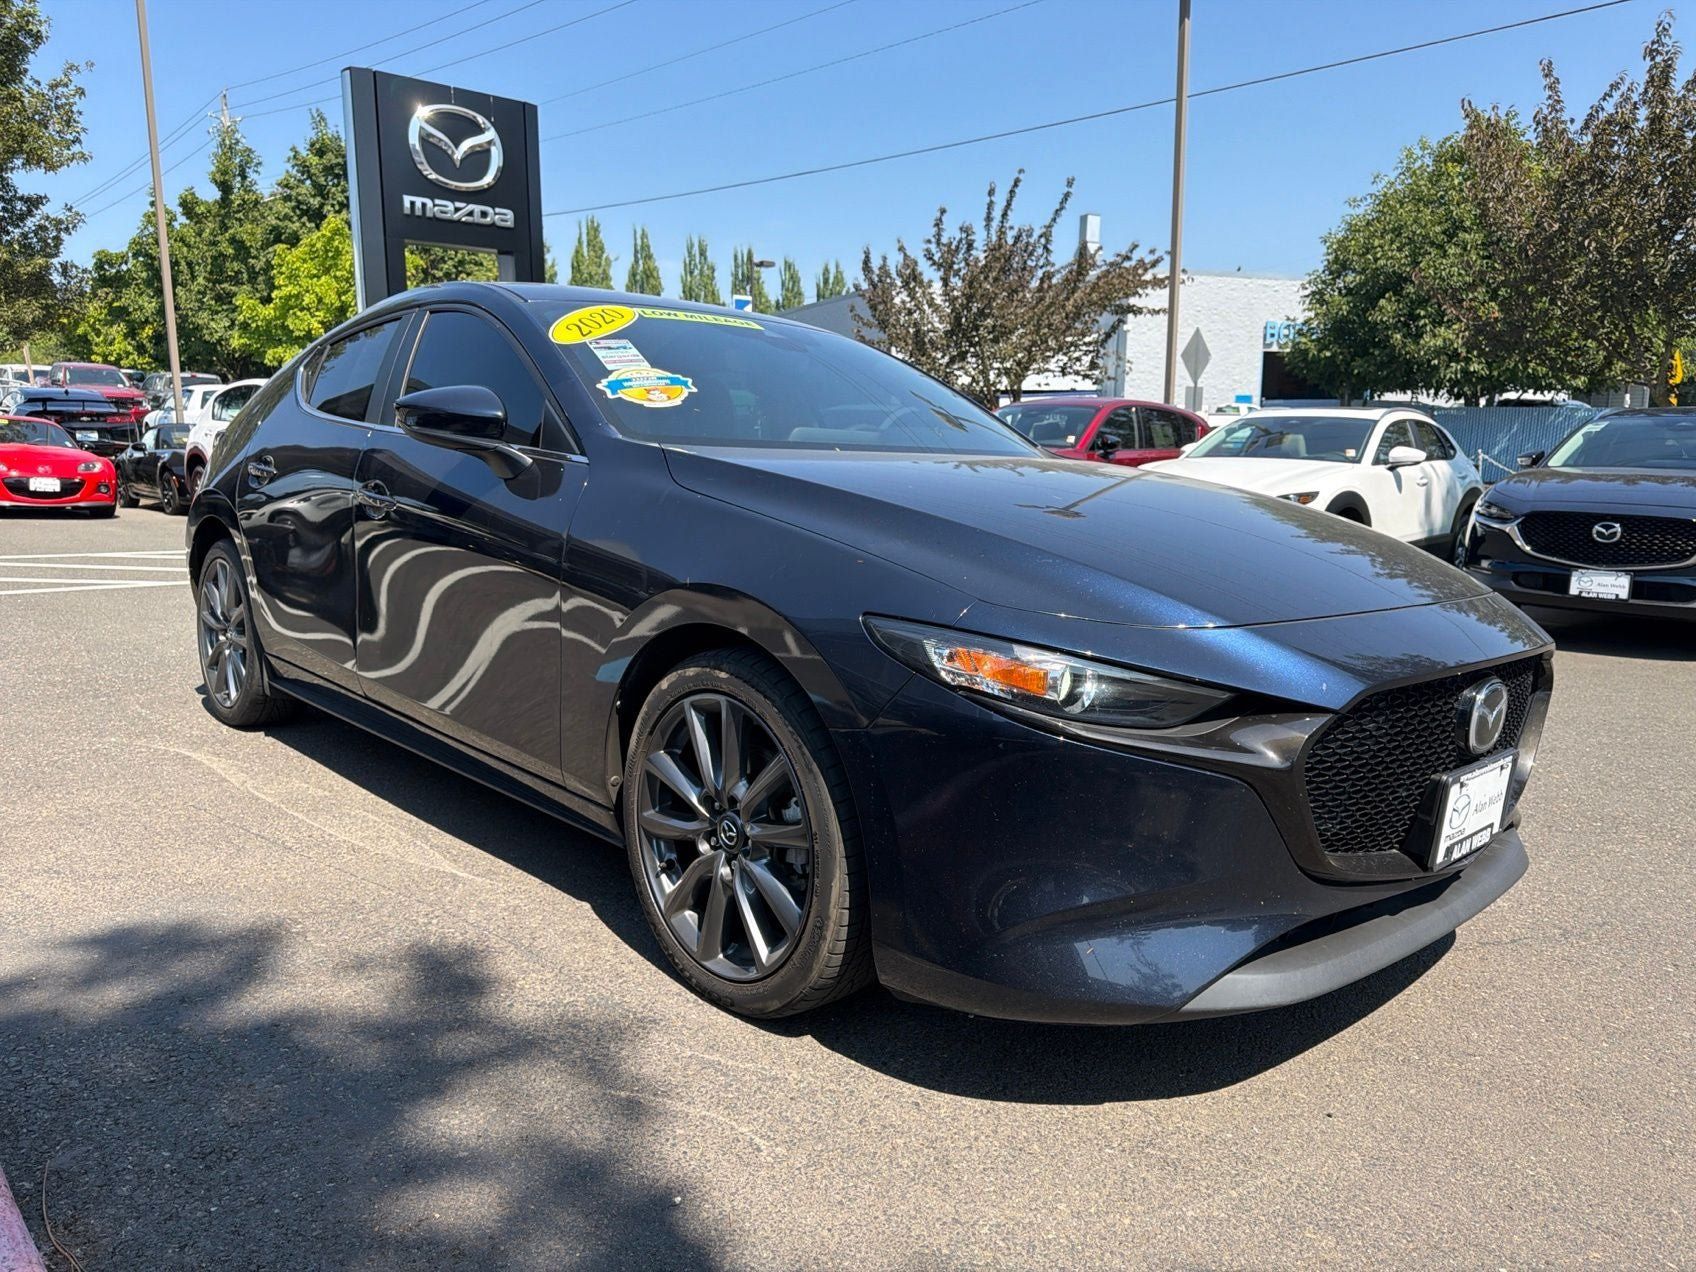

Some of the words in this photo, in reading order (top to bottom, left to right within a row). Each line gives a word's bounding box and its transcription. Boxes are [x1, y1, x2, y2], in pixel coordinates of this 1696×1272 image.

[566, 309, 625, 337] 2020
[641, 309, 680, 318] LOW
[684, 313, 758, 328] MILEAGE
[1472, 801, 1488, 816] Alan
[1450, 837, 1471, 861] ALAN
[1472, 827, 1492, 849] WEBB
